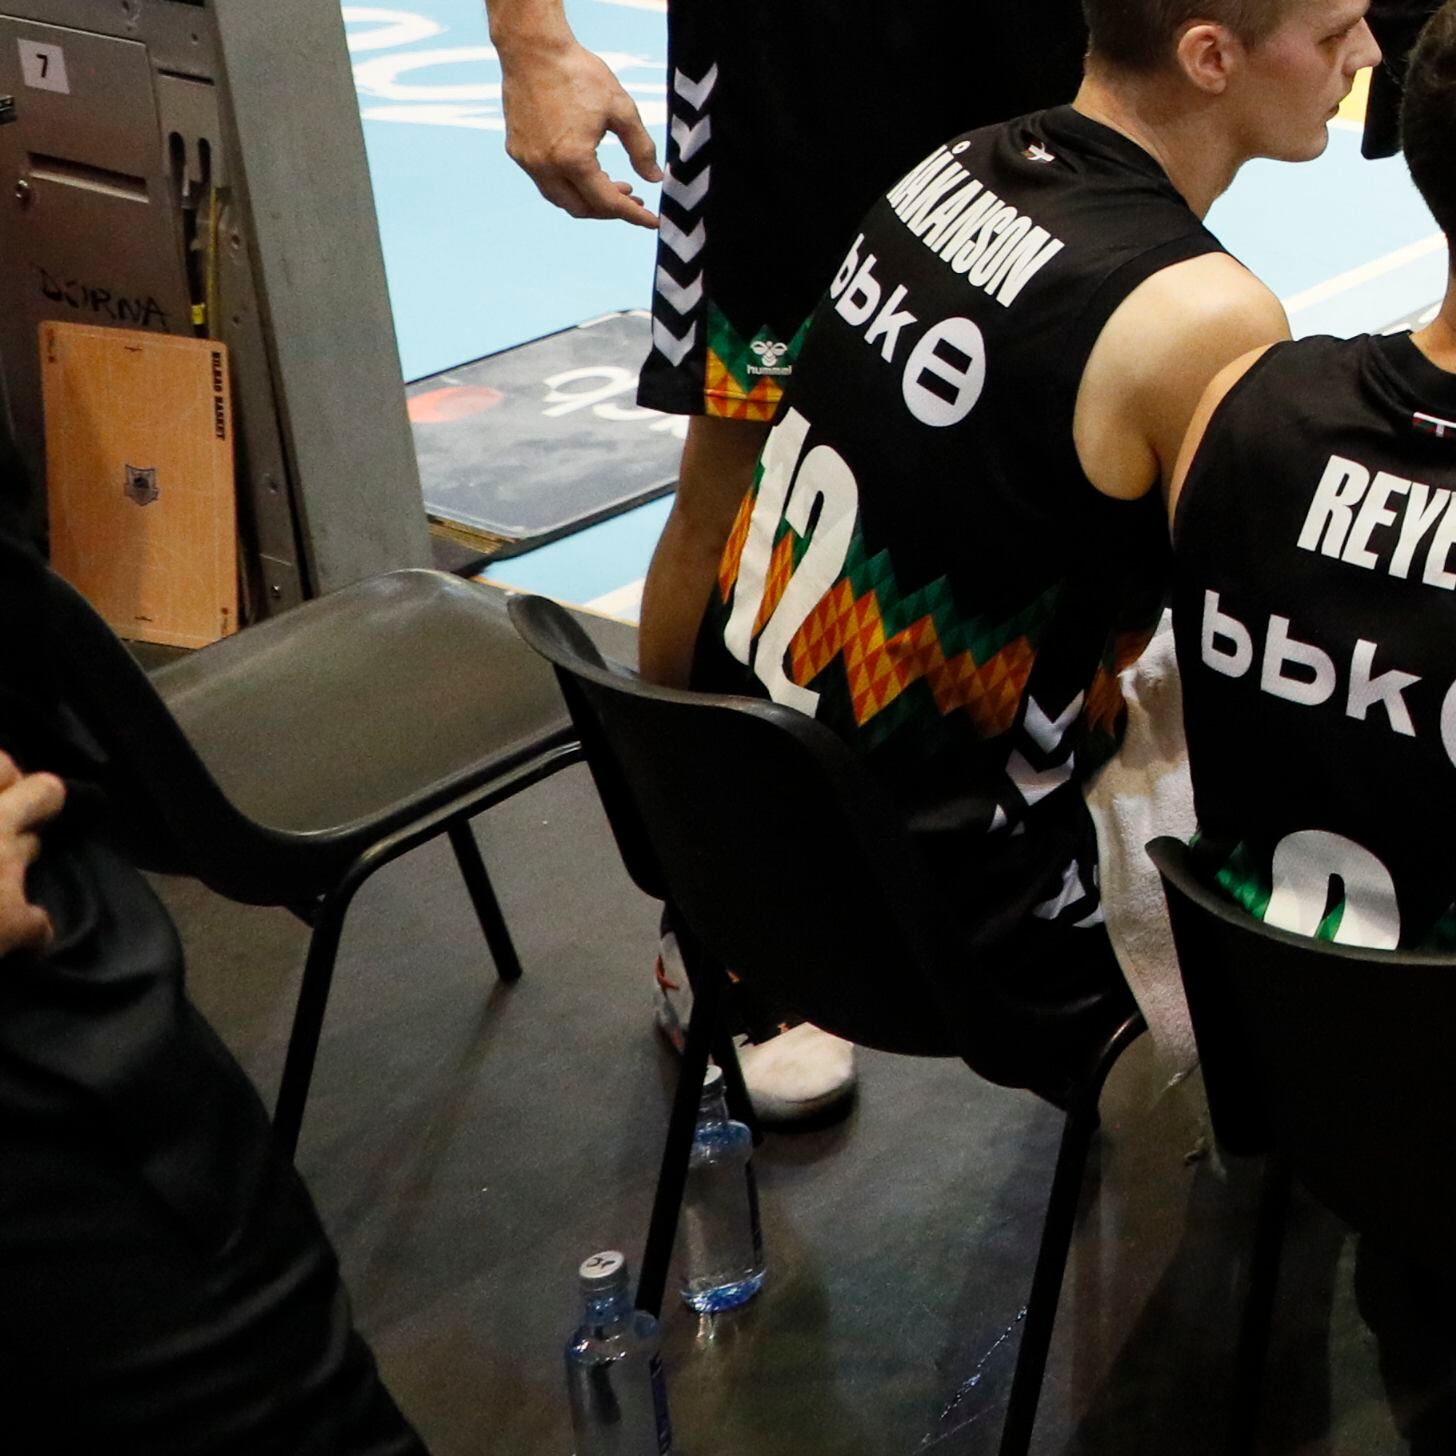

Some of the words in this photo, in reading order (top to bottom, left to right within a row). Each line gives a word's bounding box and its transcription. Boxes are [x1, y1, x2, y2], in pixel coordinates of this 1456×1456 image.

[36, 54, 48, 78] 7
[829, 232, 919, 364] bbk
[746, 364, 793, 377] hummel
[723, 406, 860, 719] 12
[1200, 589, 1423, 738] bbk
